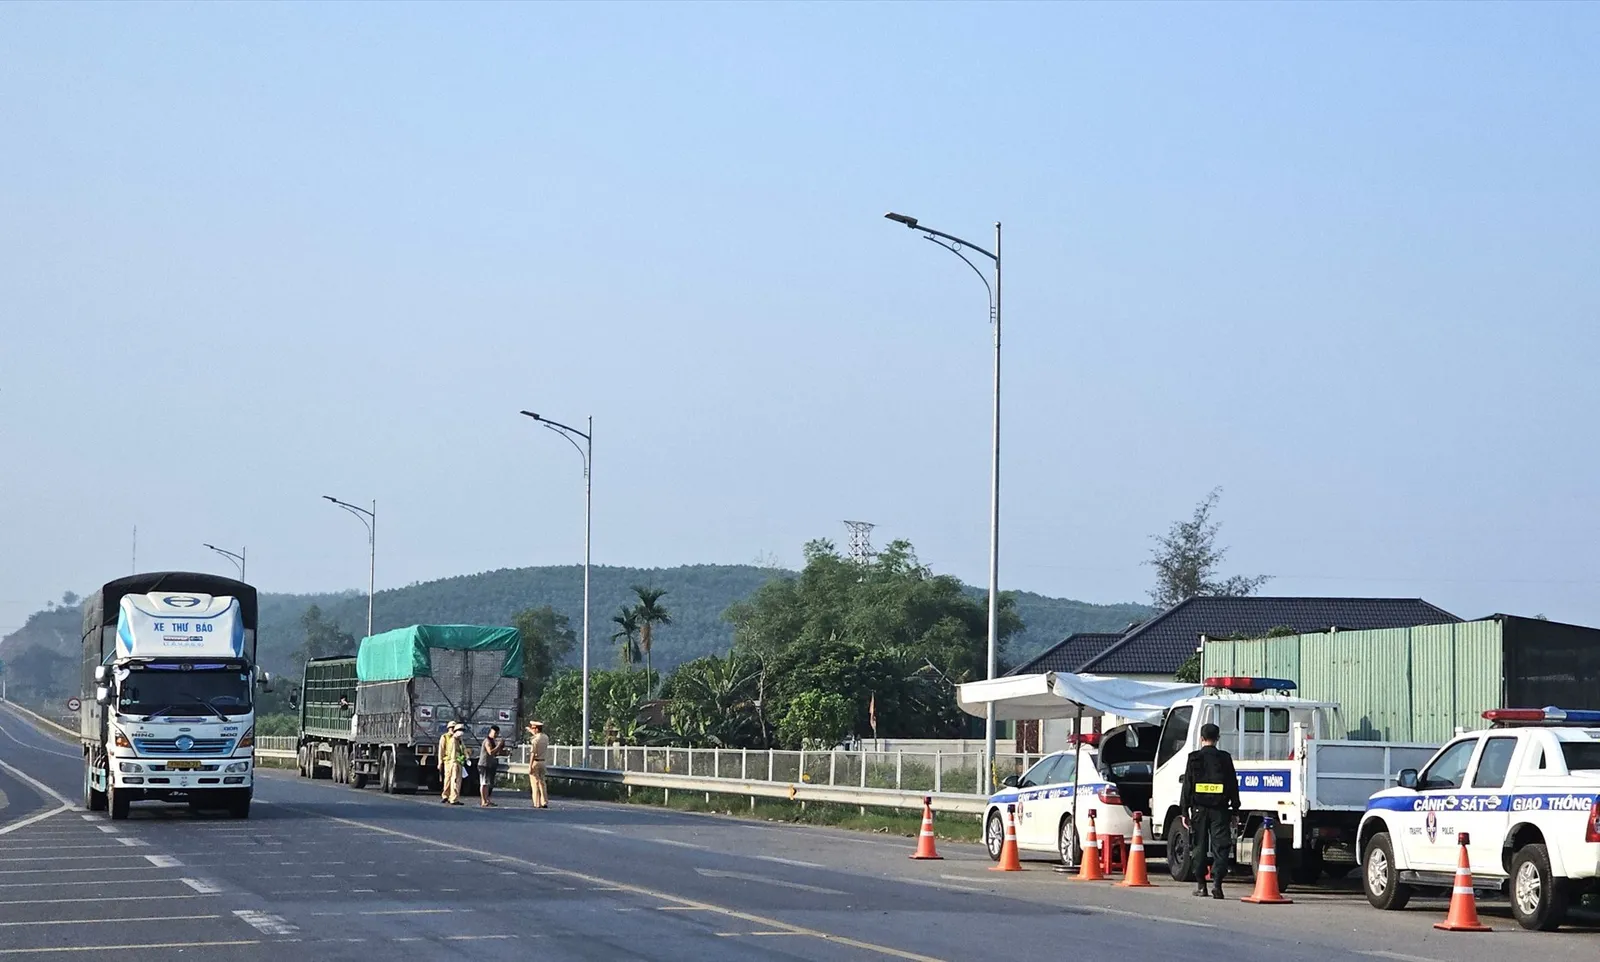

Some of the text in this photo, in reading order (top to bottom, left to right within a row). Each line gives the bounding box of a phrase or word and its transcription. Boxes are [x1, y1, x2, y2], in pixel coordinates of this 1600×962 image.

[154, 622, 164, 632] XE
[172, 622, 189, 632] THƯ
[1245, 776, 1259, 786] GIAO
[1262, 774, 1284, 787] THÔNG
[1414, 794, 1592, 811] CẢNH SÁT GIAO THÔNG
